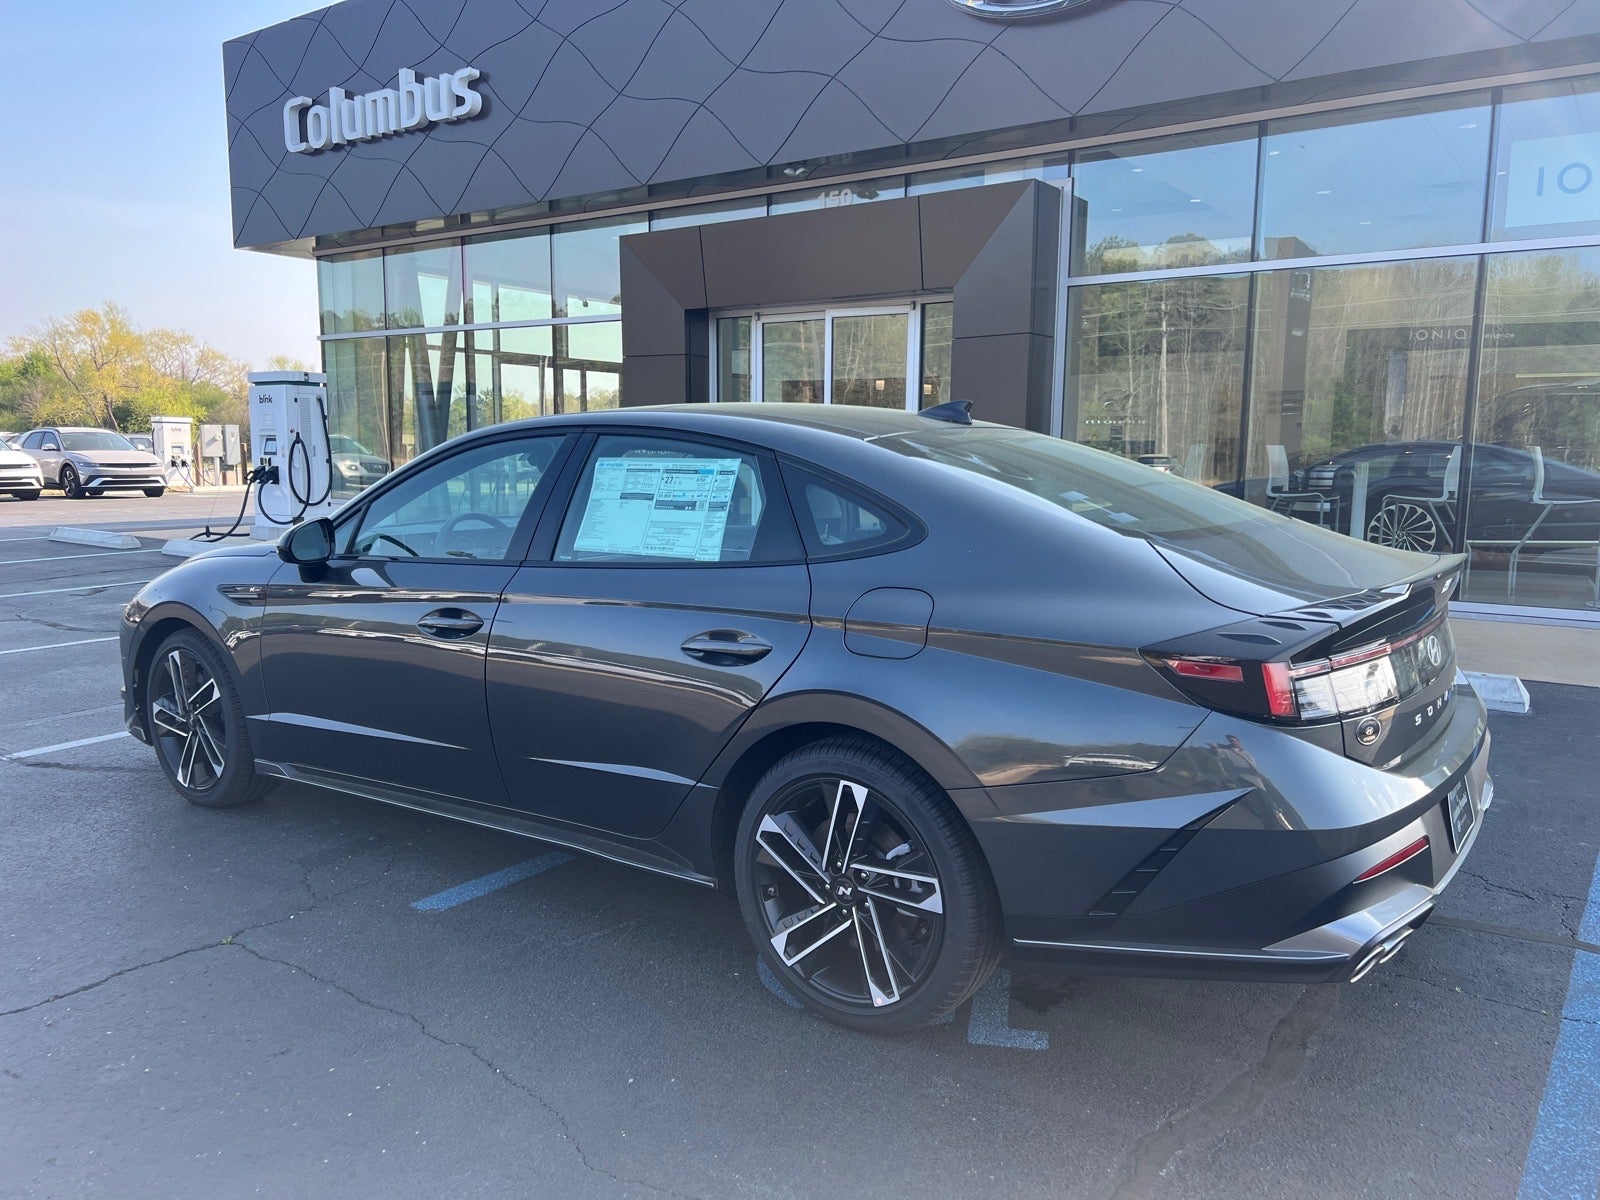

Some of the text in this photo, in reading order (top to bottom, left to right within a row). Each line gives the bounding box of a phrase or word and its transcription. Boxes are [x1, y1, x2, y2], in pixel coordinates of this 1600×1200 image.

[283, 67, 482, 153] Columbus
[818, 188, 852, 208] 150
[1409, 328, 1466, 341] IONIQ
[258, 394, 273, 404] blink
[664, 476, 674, 484] 27
[837, 885, 852, 896] N
